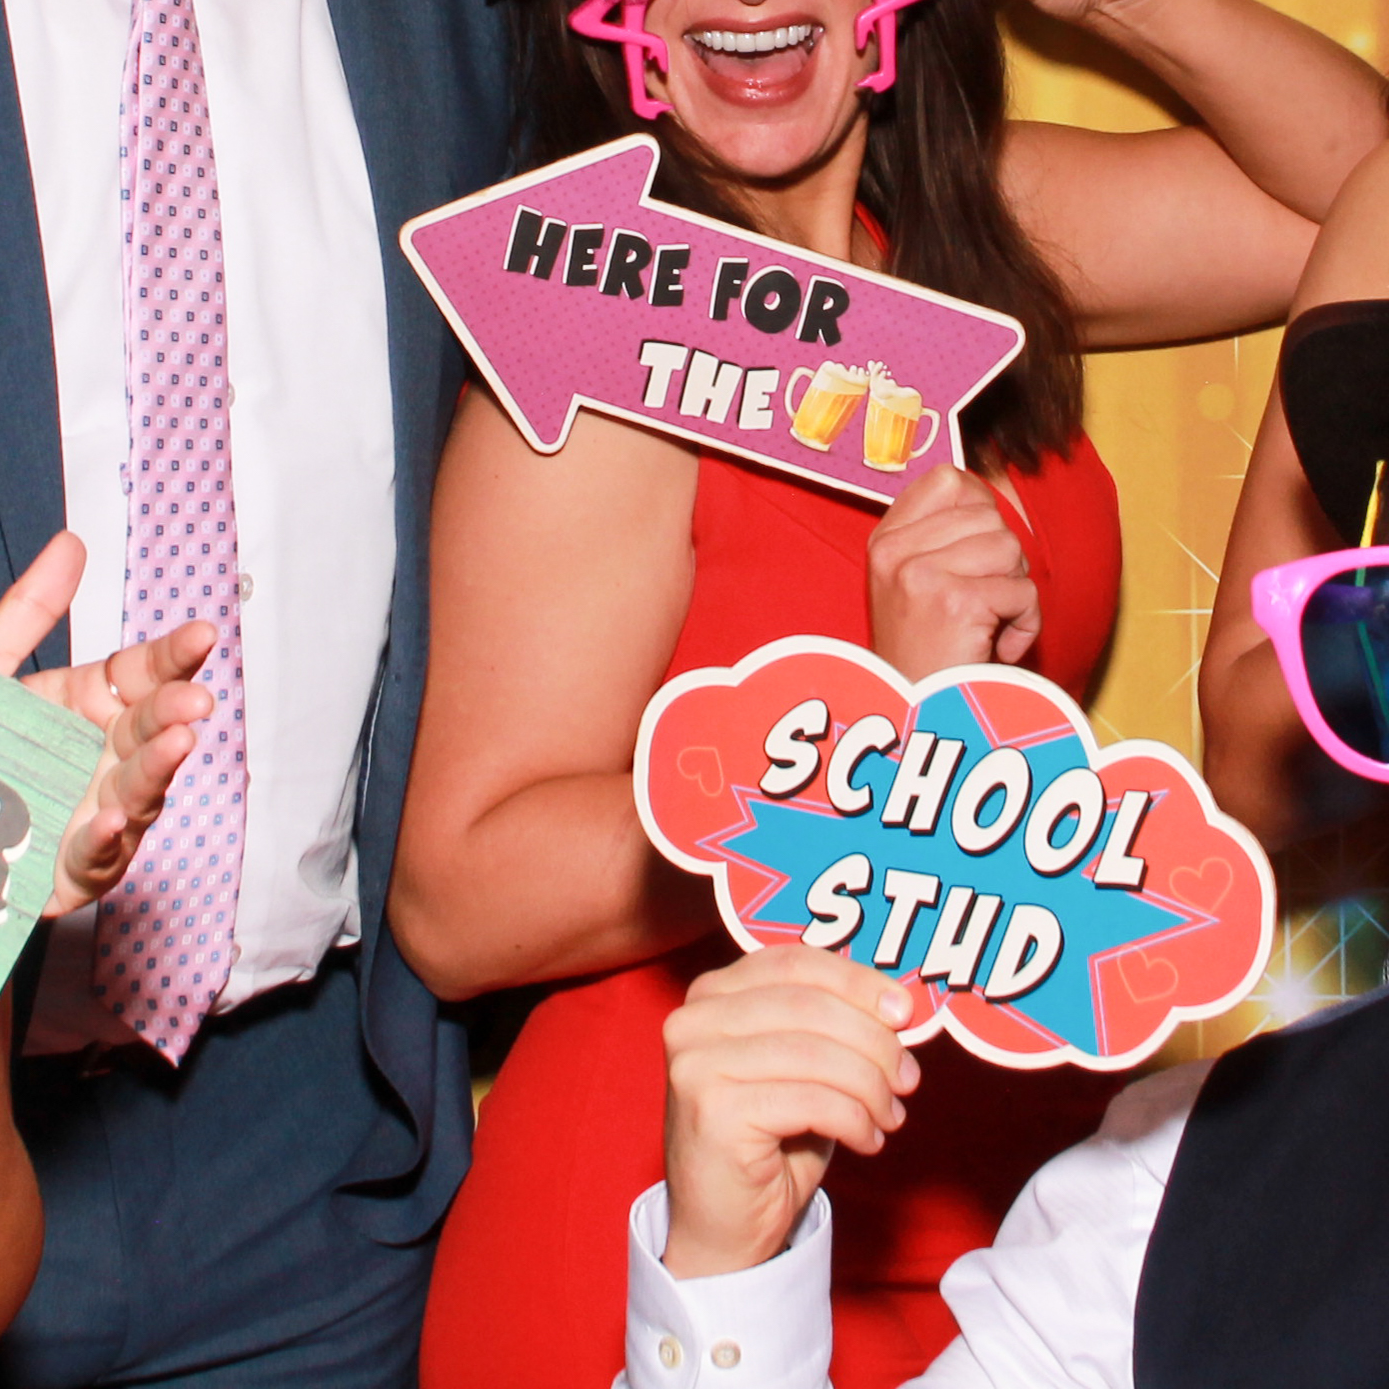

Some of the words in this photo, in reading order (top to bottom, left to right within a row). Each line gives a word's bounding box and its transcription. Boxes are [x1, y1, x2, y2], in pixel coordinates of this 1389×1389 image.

[503, 204, 690, 307] HERE
[709, 258, 850, 346] FOR
[639, 340, 780, 430] THE
[759, 698, 1152, 892] SCHOOL
[800, 853, 1065, 1003] STUD
